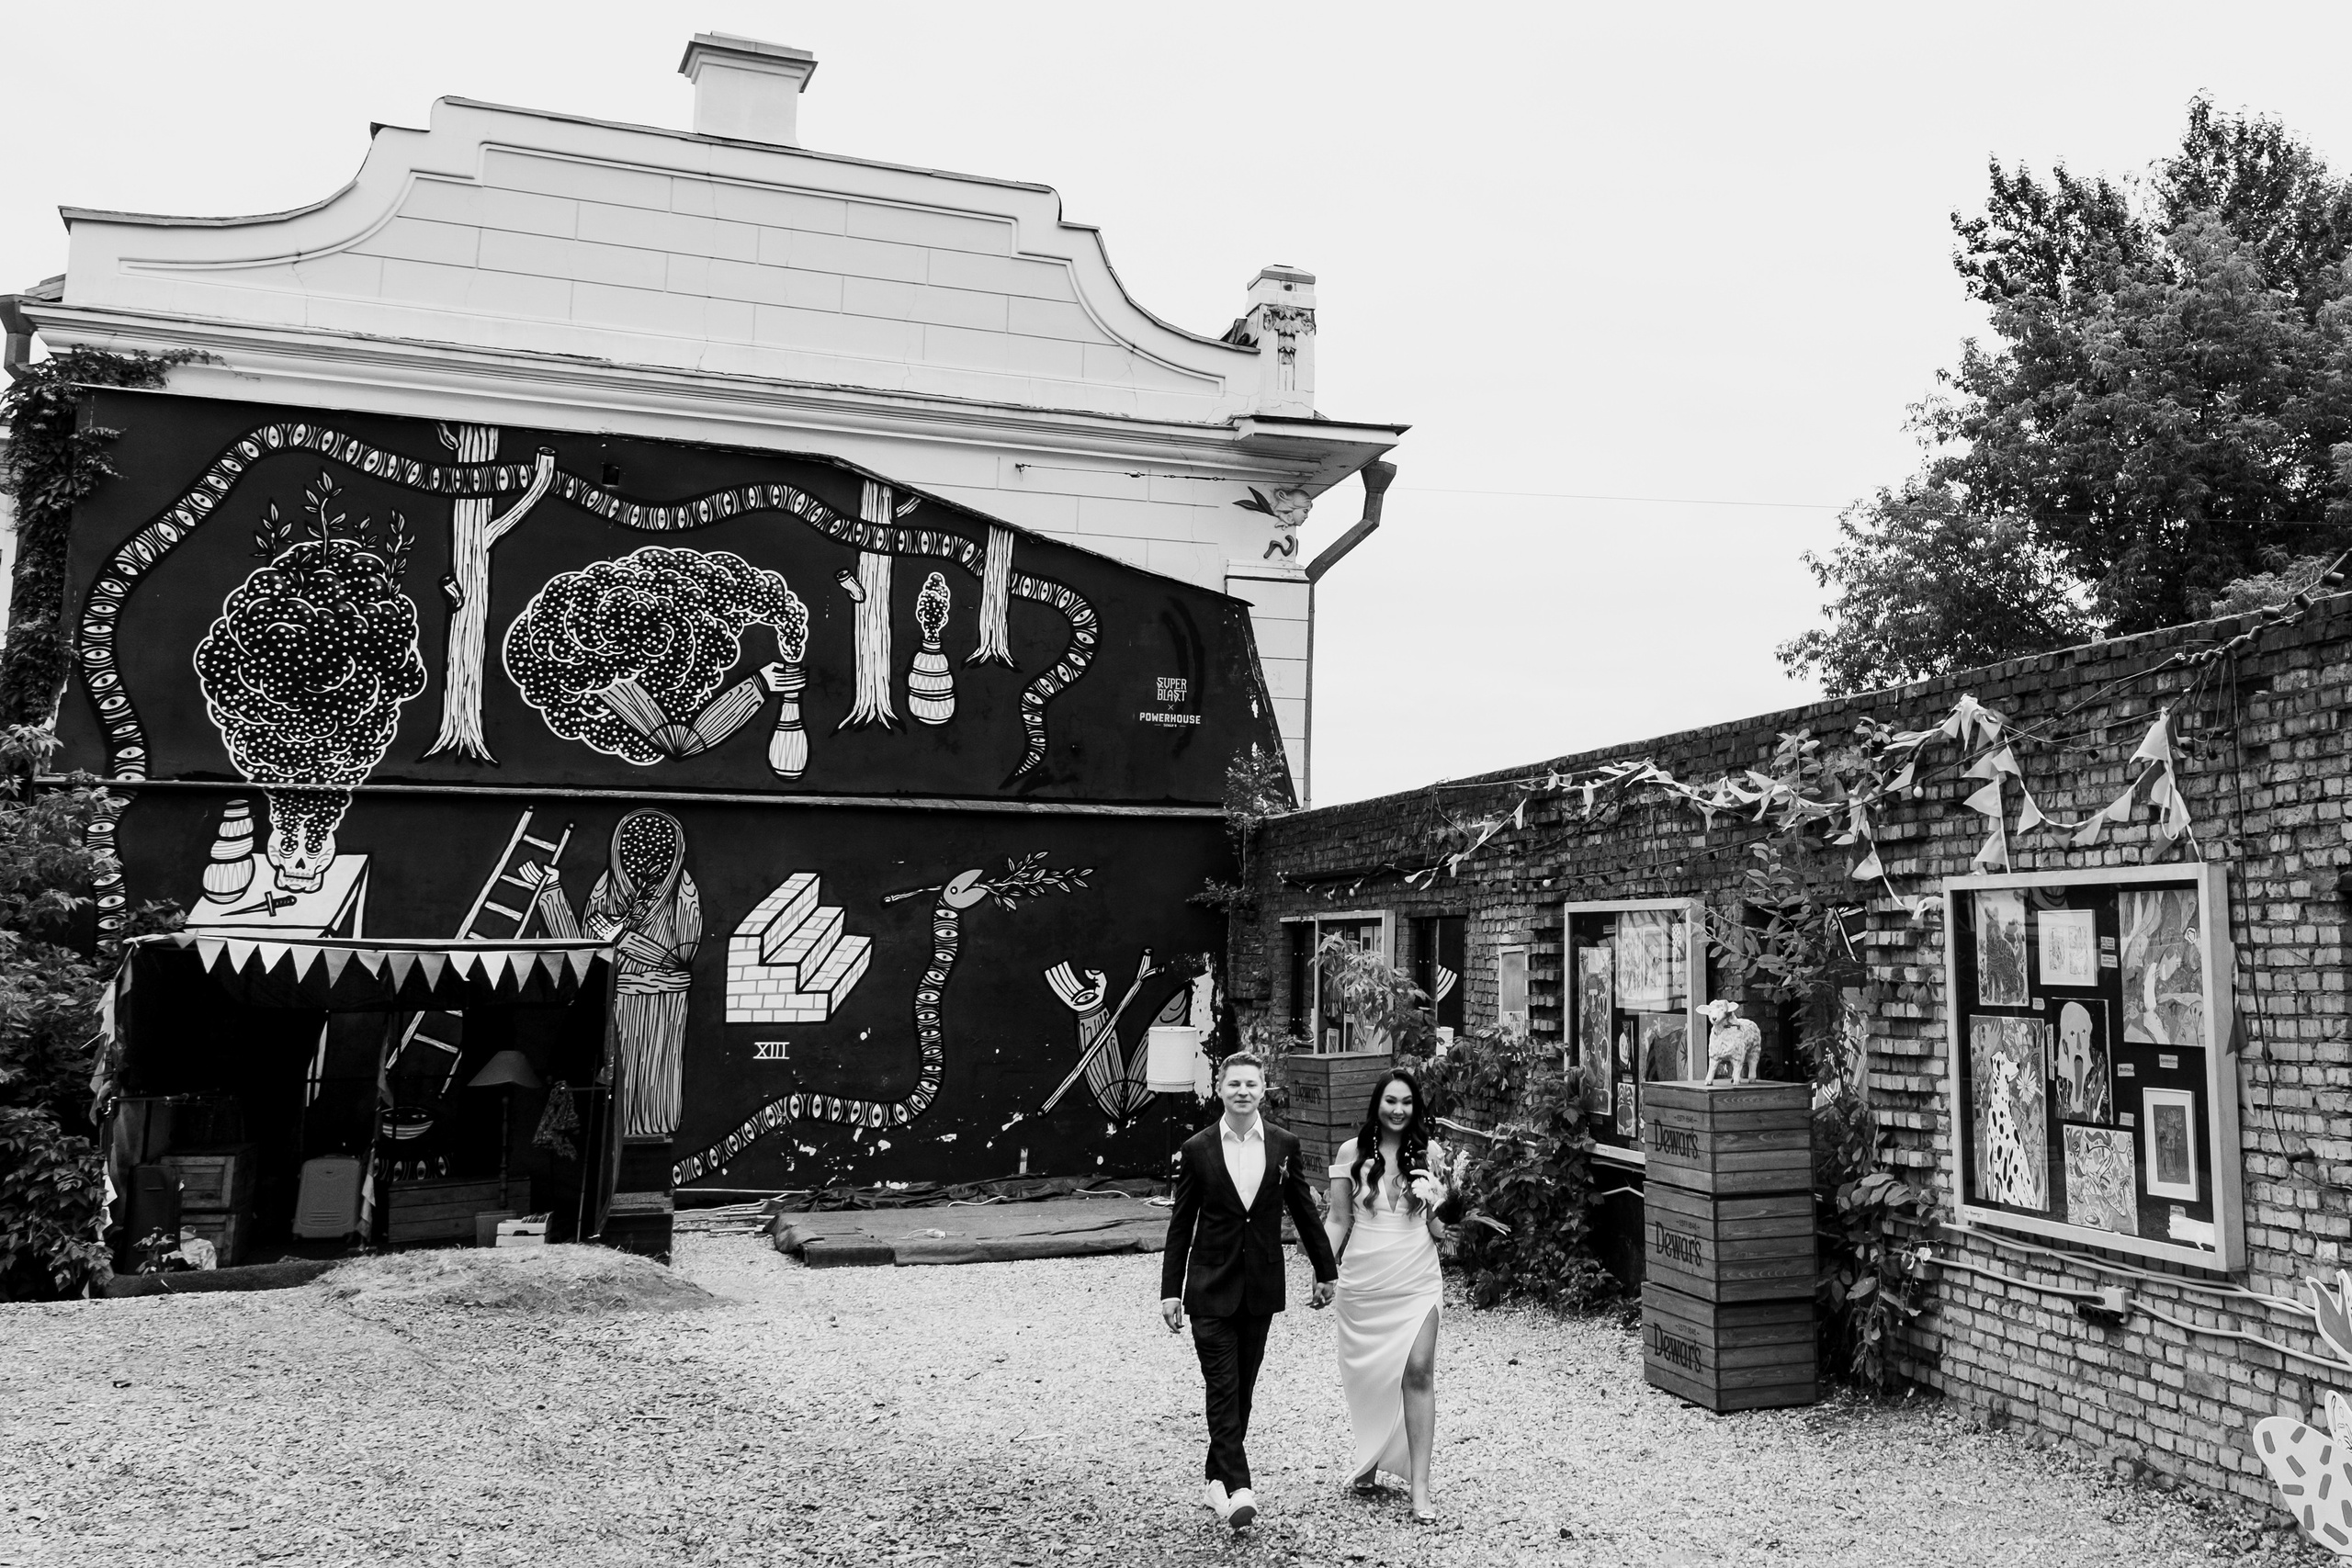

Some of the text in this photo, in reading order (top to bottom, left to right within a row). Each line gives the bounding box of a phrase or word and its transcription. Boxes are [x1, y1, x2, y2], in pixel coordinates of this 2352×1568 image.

[1157, 677, 1187, 690] SUPER
[1157, 689, 1187, 702] BLAST
[1139, 712, 1201, 725] POWERHOUSE
[752, 1042, 790, 1059] XIII
[1295, 1079, 1321, 1105] Dewar's
[1654, 1119, 1699, 1160] Dewar's
[1301, 1153, 1323, 1174] ewar's
[1655, 1221, 1702, 1268] Dewar's
[1654, 1322, 1702, 1374] Dewar's
